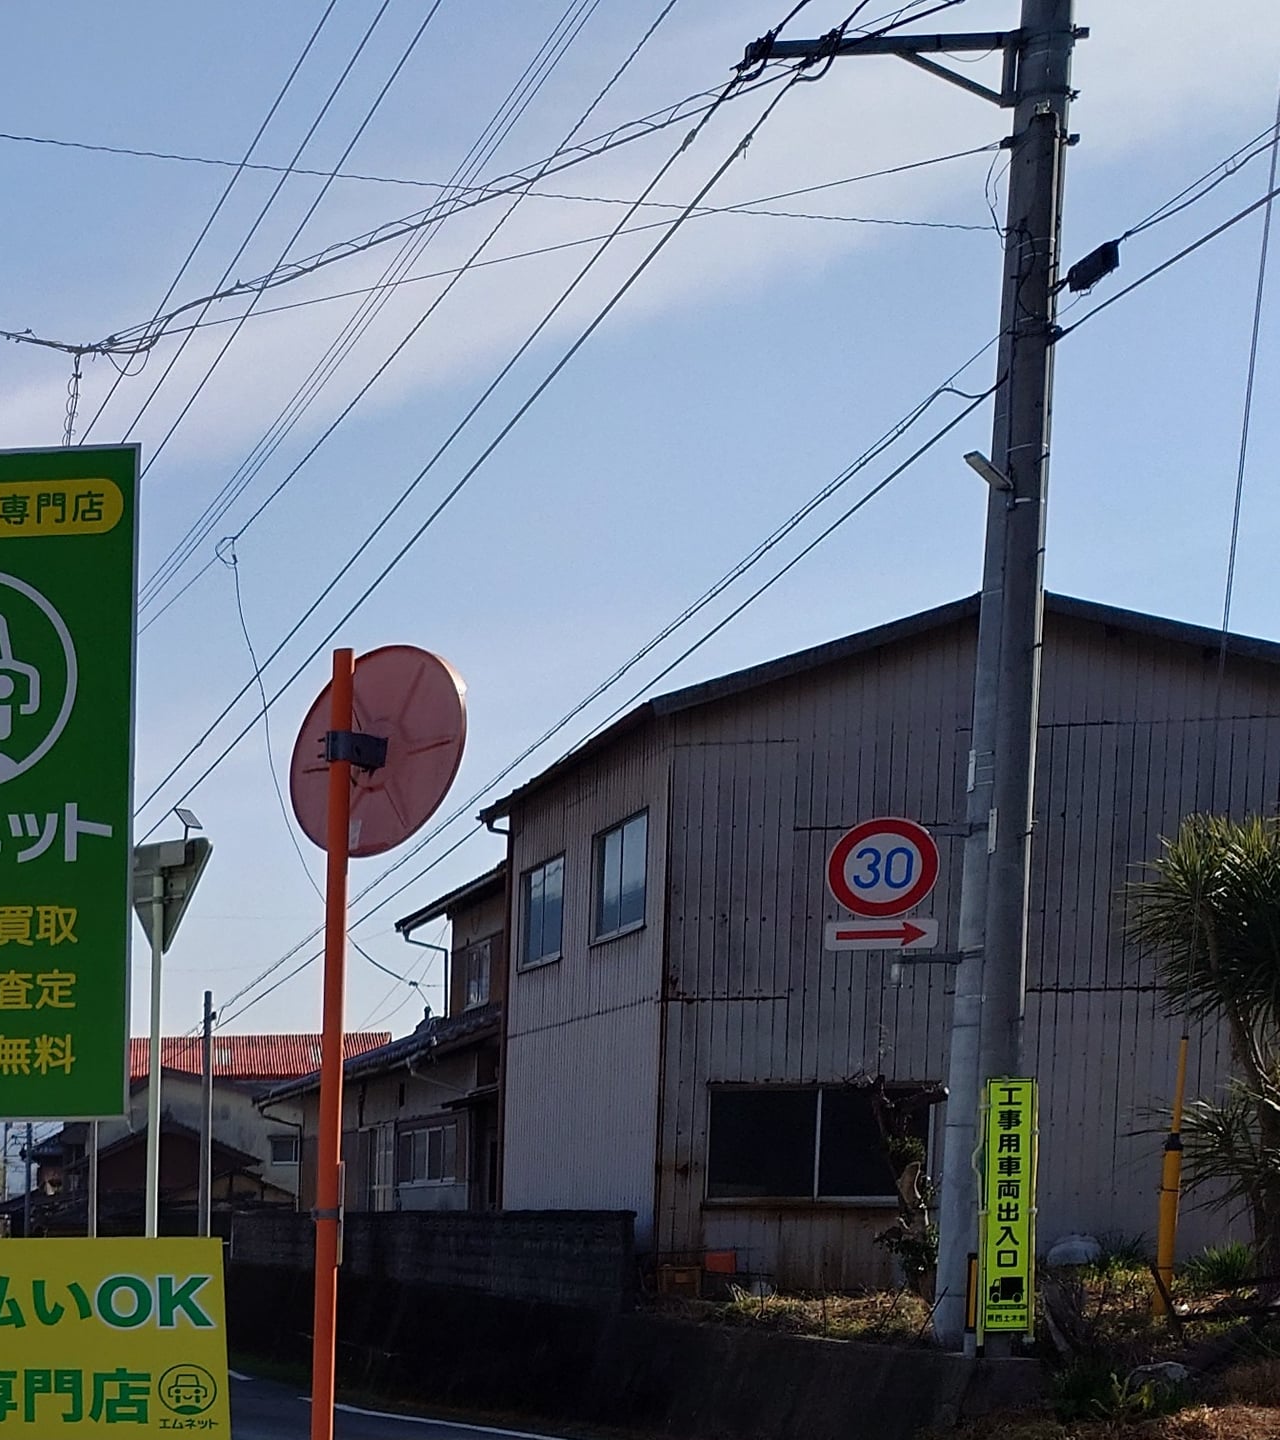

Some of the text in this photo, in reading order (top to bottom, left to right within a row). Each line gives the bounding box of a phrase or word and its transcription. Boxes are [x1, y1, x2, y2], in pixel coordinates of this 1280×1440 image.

[852, 847, 915, 890] 30
[995, 1086, 1023, 1269] 工事用車両出入口
[159, 1417, 220, 1431] エムネット
